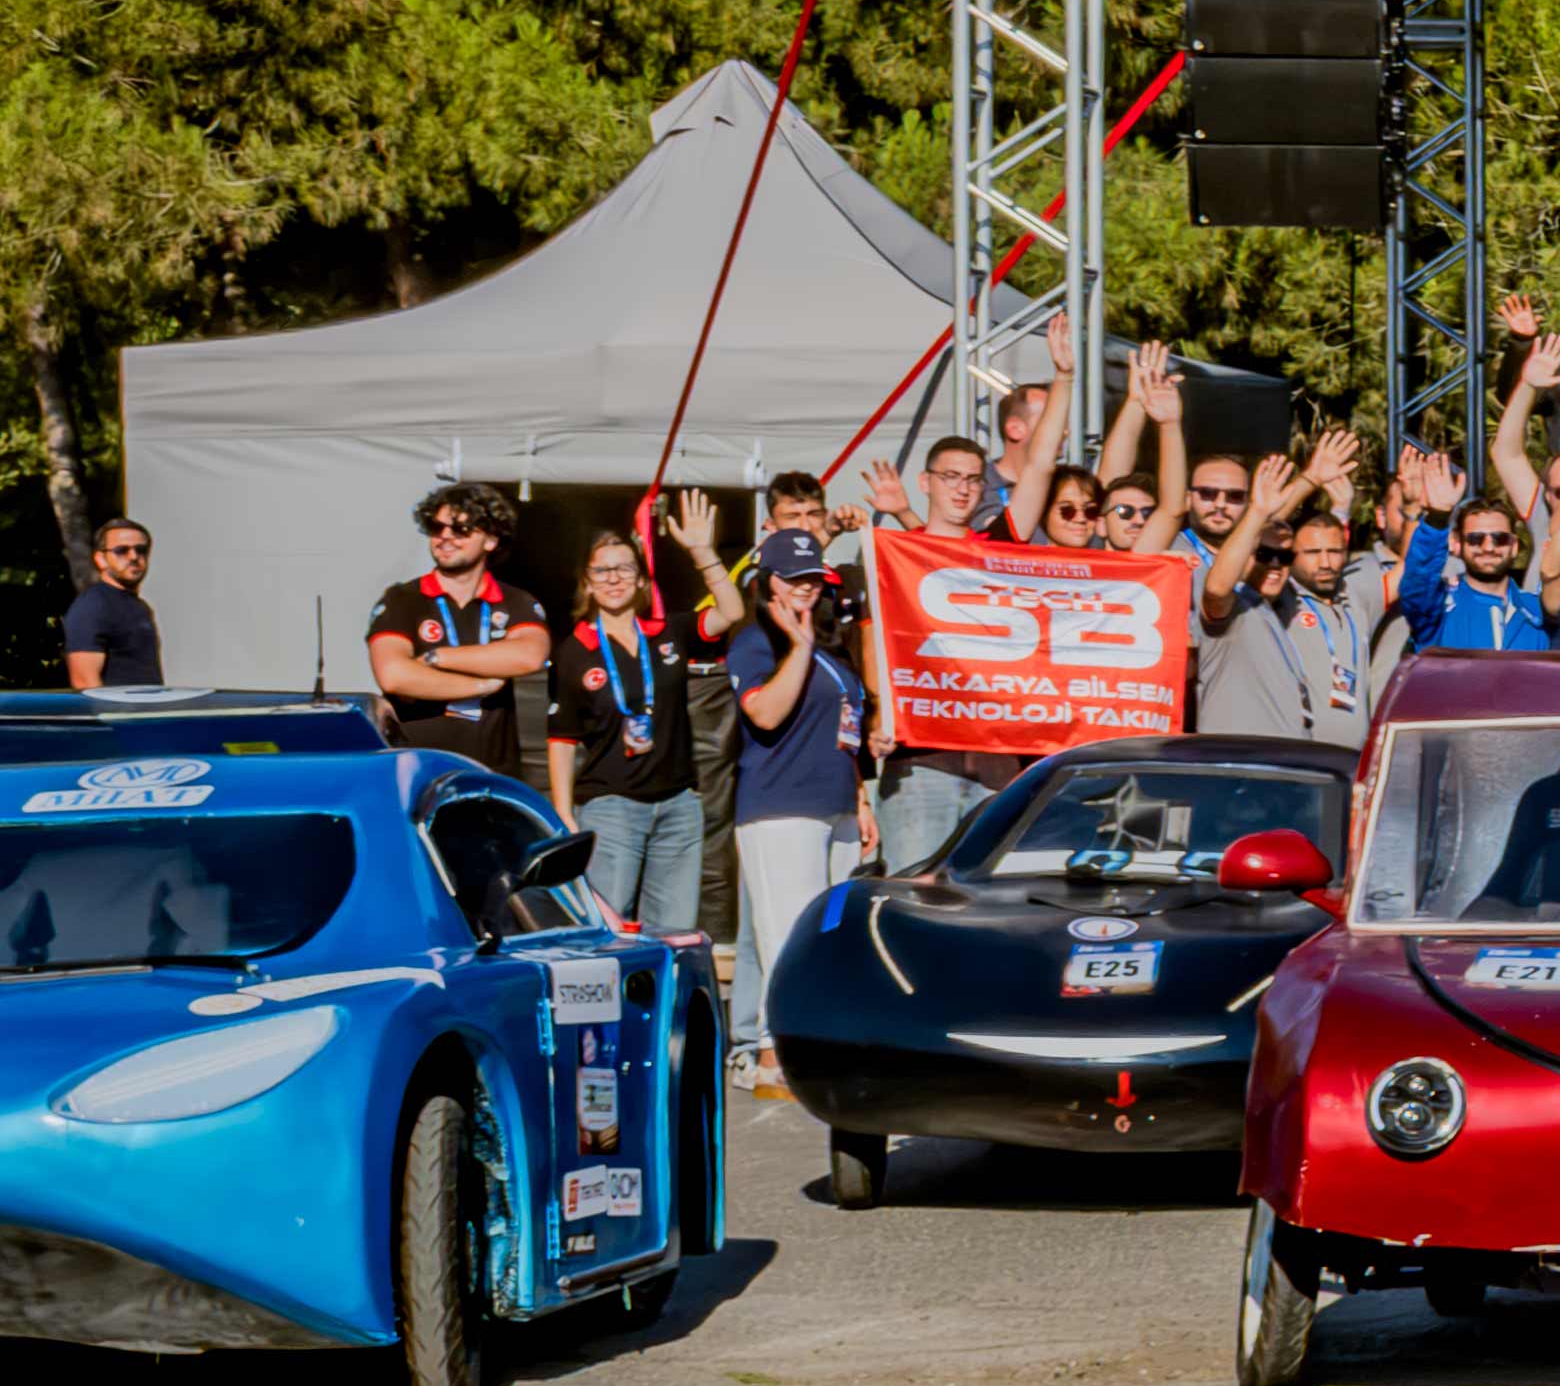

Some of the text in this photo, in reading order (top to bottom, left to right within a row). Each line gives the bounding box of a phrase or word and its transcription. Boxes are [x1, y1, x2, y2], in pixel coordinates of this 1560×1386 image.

[981, 584, 1104, 612] TECH
[892, 668, 1059, 697] SAKARYA
[897, 696, 1072, 724] TEKNOLOJİ
[1085, 960, 1141, 978] E25
[1495, 965, 1558, 982] E21
